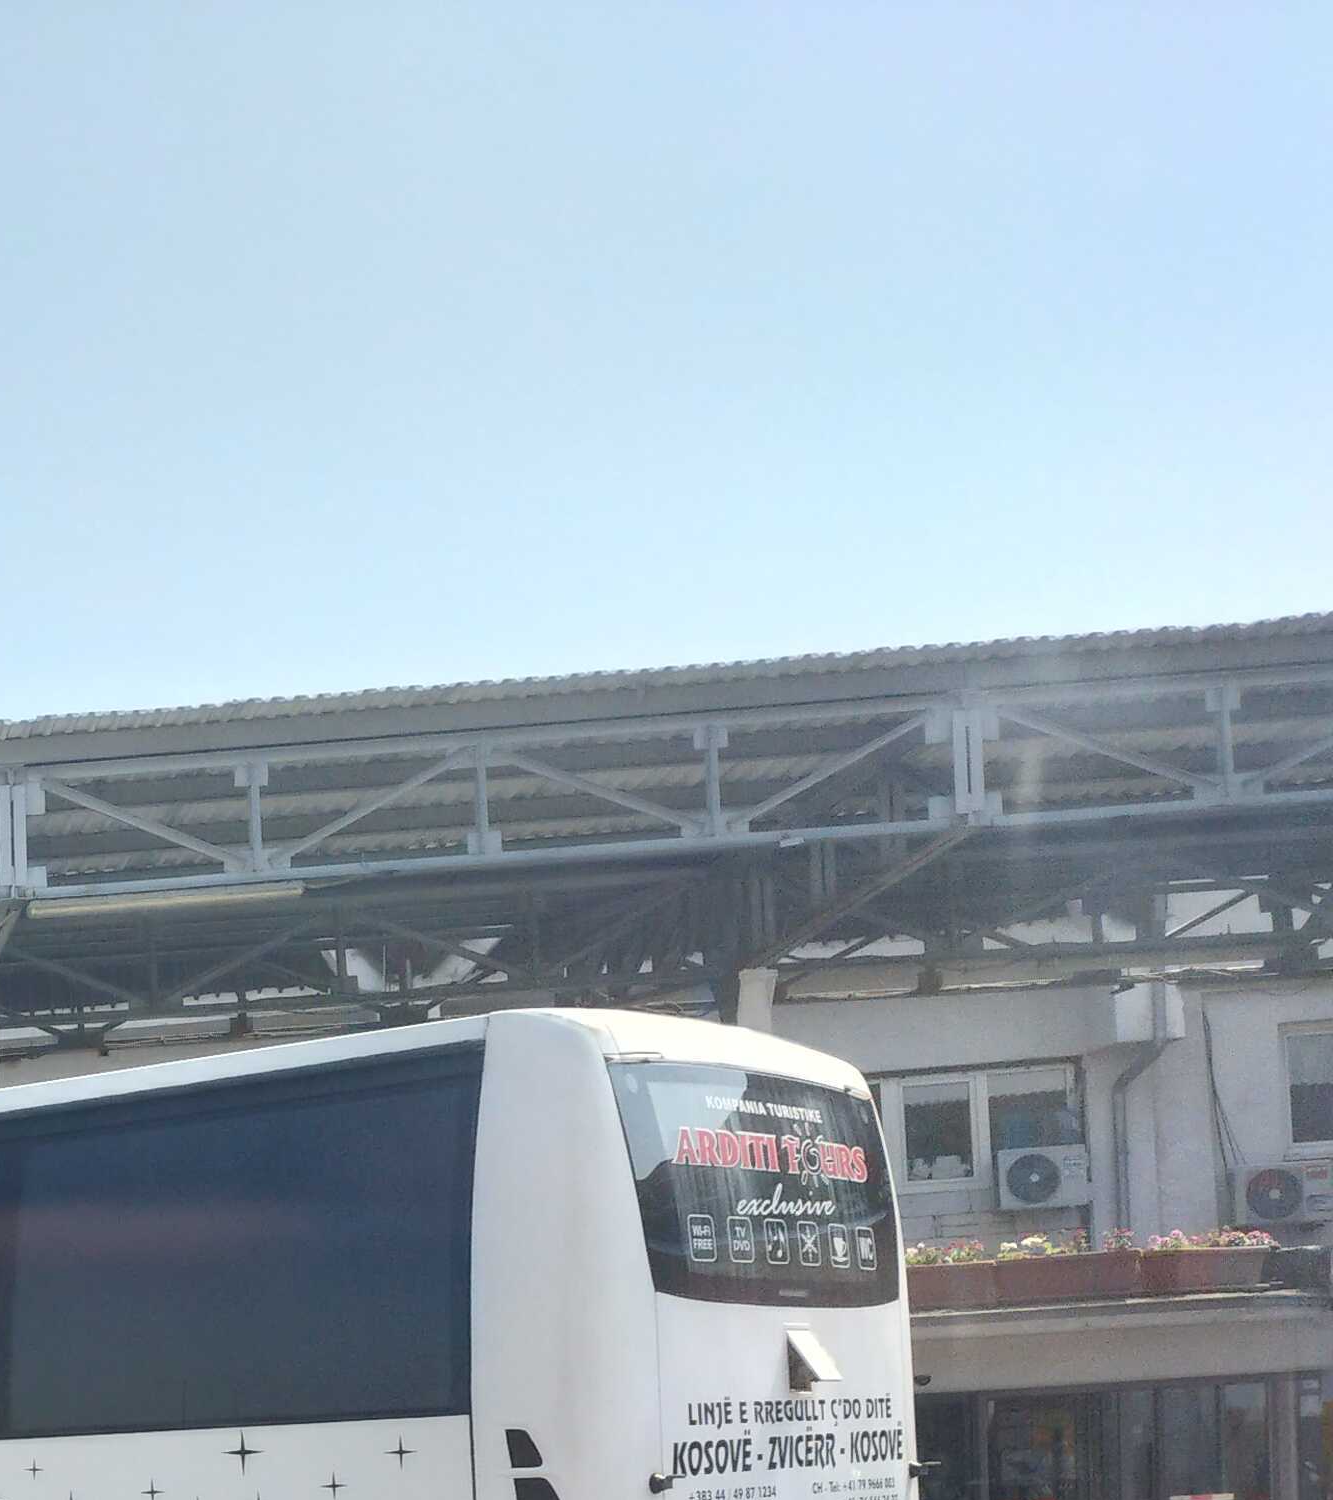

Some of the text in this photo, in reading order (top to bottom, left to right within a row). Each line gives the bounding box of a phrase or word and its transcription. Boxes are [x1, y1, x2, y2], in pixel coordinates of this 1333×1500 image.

[705, 1095, 823, 1124] KOMPANIA TURISTIKE
[672, 1126, 868, 1183] ARDITI TOURS
[737, 1183, 836, 1216] exclusive
[693, 1238, 713, 1250] FREE
[733, 1240, 750, 1251] DVD
[735, 1226, 746, 1238] TV
[688, 1396, 733, 1429] LINJË
[740, 1401, 748, 1423] E
[754, 1399, 826, 1424] RREGULLT
[866, 1393, 892, 1419] DITË
[673, 1430, 752, 1476] KOSOVË
[767, 1426, 836, 1470] ZVICËRR
[850, 1421, 903, 1464] KOSOVË
[715, 1489, 725, 1500] 44
[733, 1488, 743, 1499] 49
